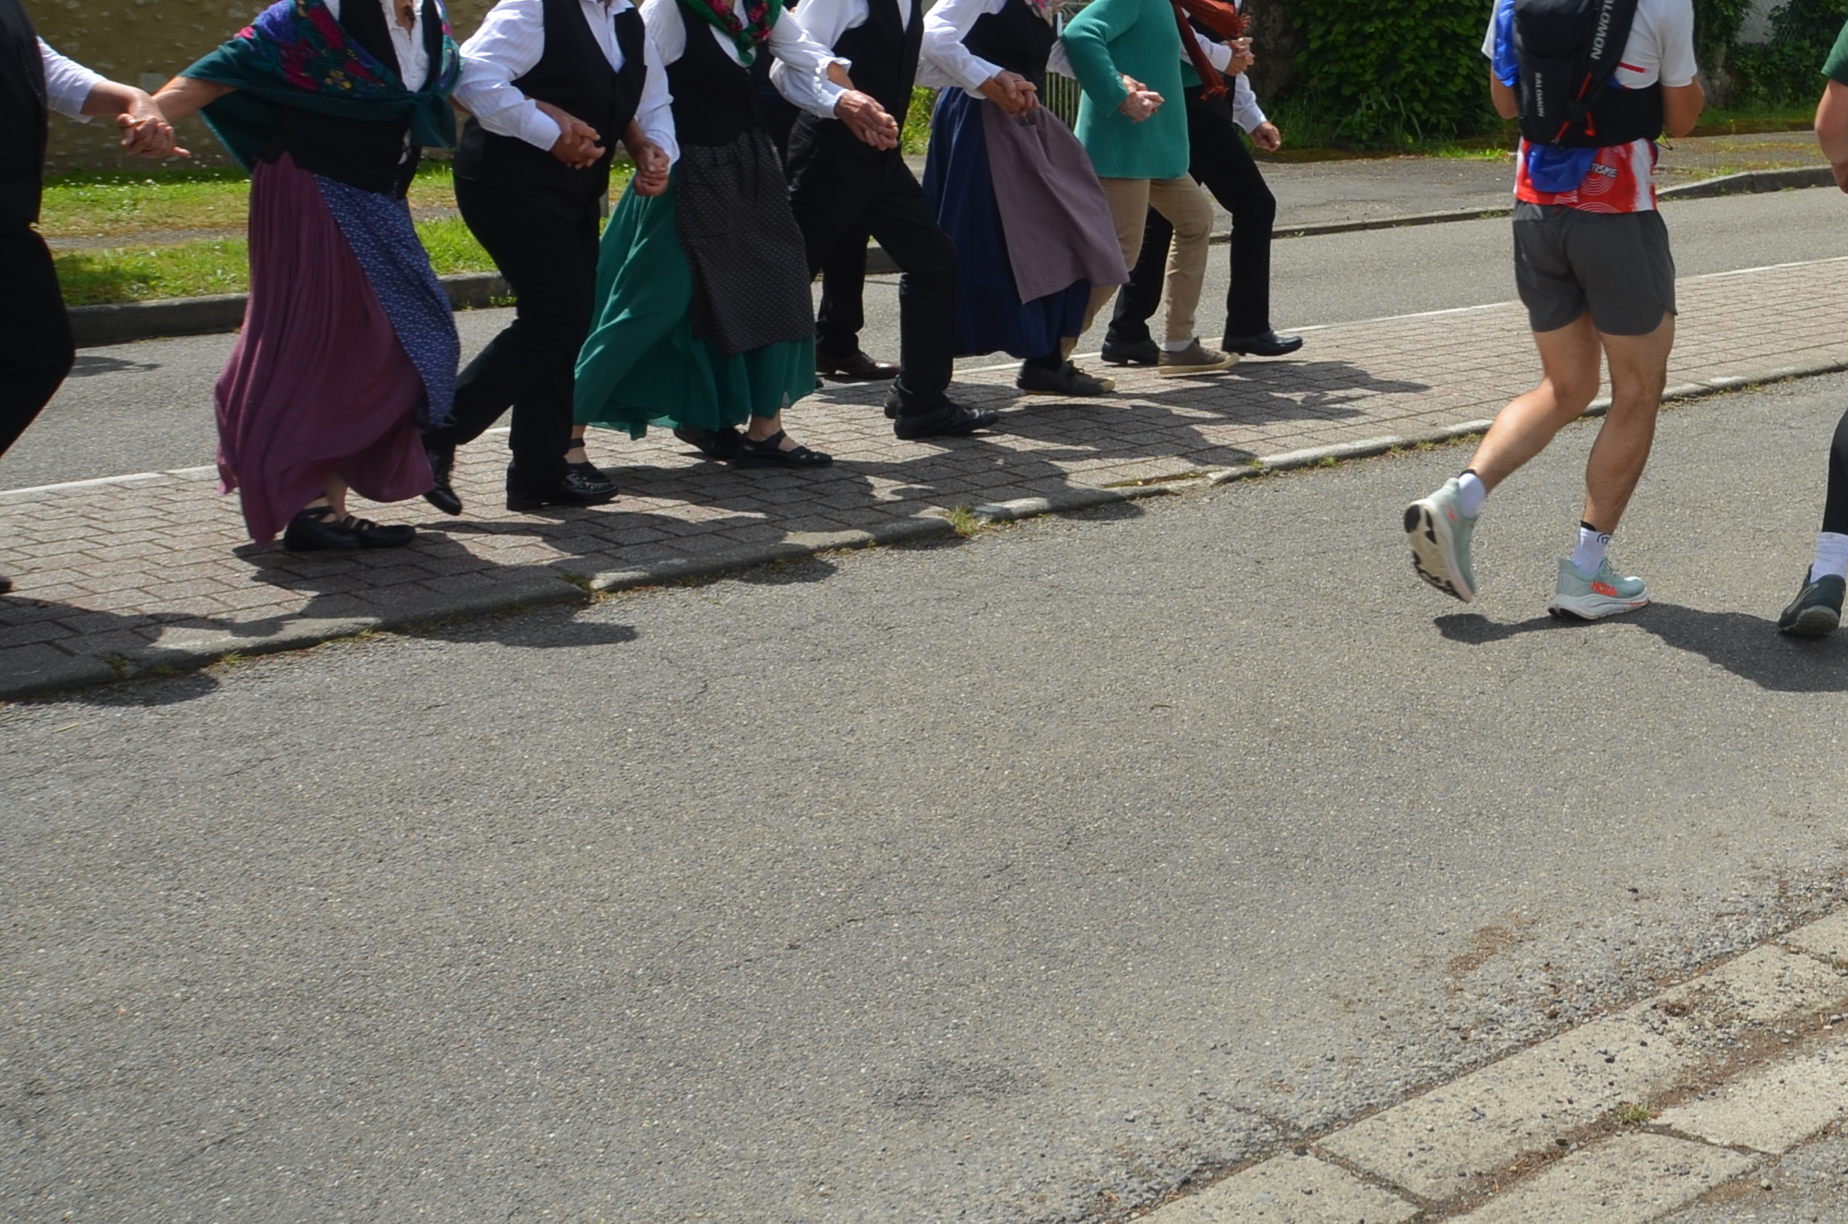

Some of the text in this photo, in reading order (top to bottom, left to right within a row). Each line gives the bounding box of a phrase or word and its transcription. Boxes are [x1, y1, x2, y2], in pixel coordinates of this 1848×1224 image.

[1535, 72, 1545, 117] SALOMON
[1588, 163, 1618, 178] TISME
[1590, 580, 1618, 597] HOKA
